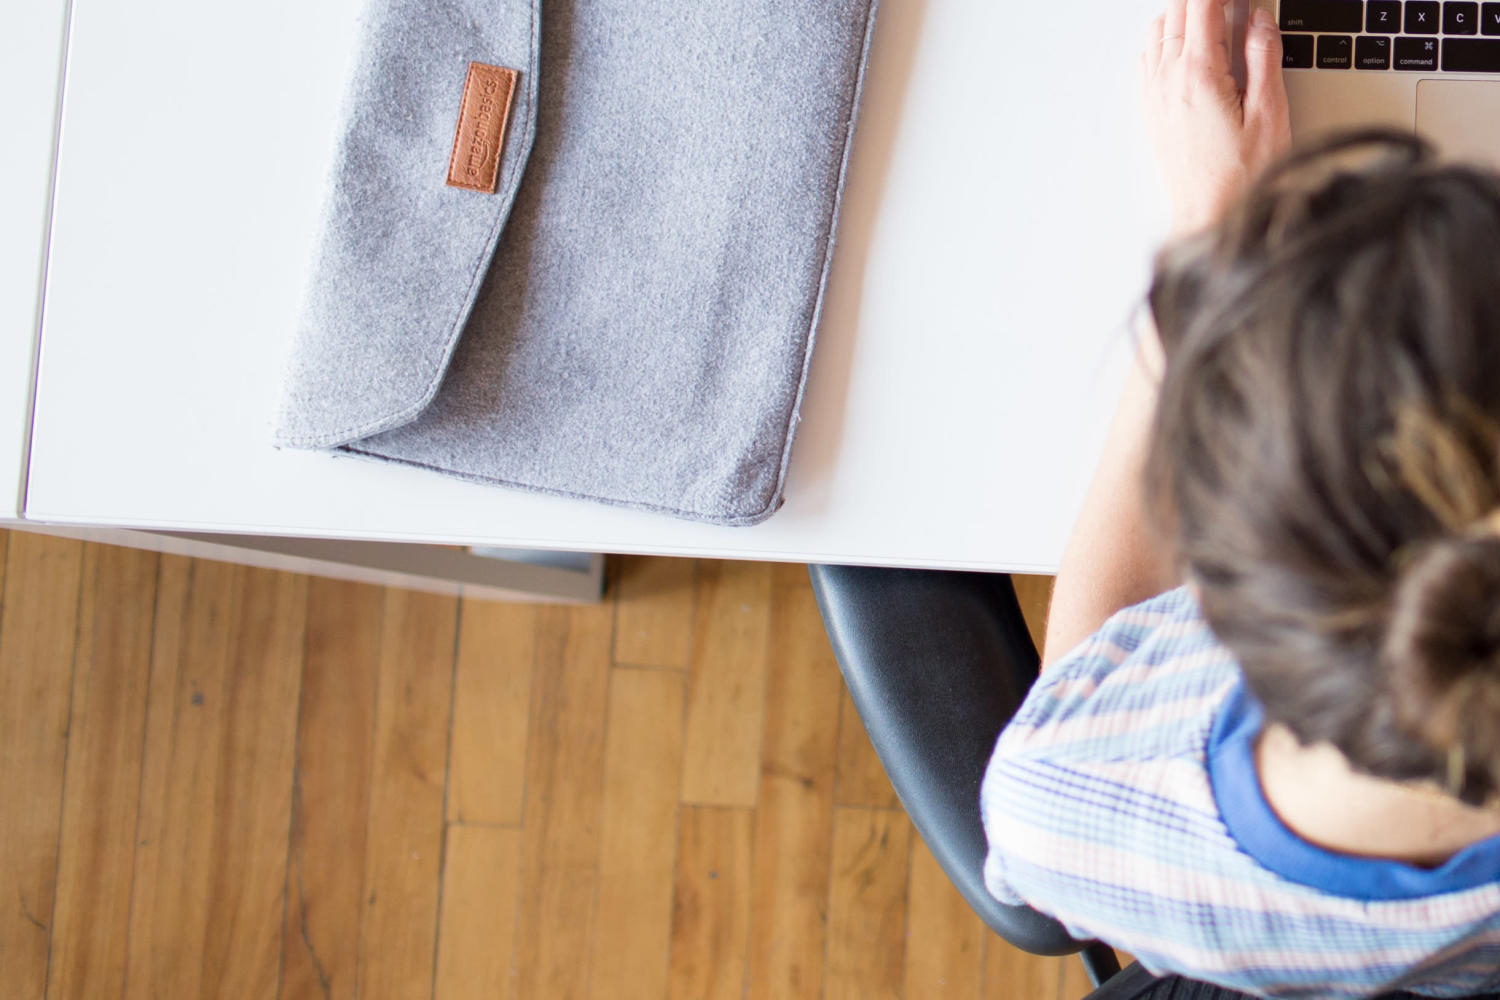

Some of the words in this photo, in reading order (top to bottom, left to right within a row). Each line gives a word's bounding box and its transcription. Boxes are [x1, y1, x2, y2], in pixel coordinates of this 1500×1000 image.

[1322, 56, 1348, 64] control
[1362, 57, 1385, 65] option
[1399, 58, 1433, 66] command
[467, 79, 498, 177] amazonbasics
